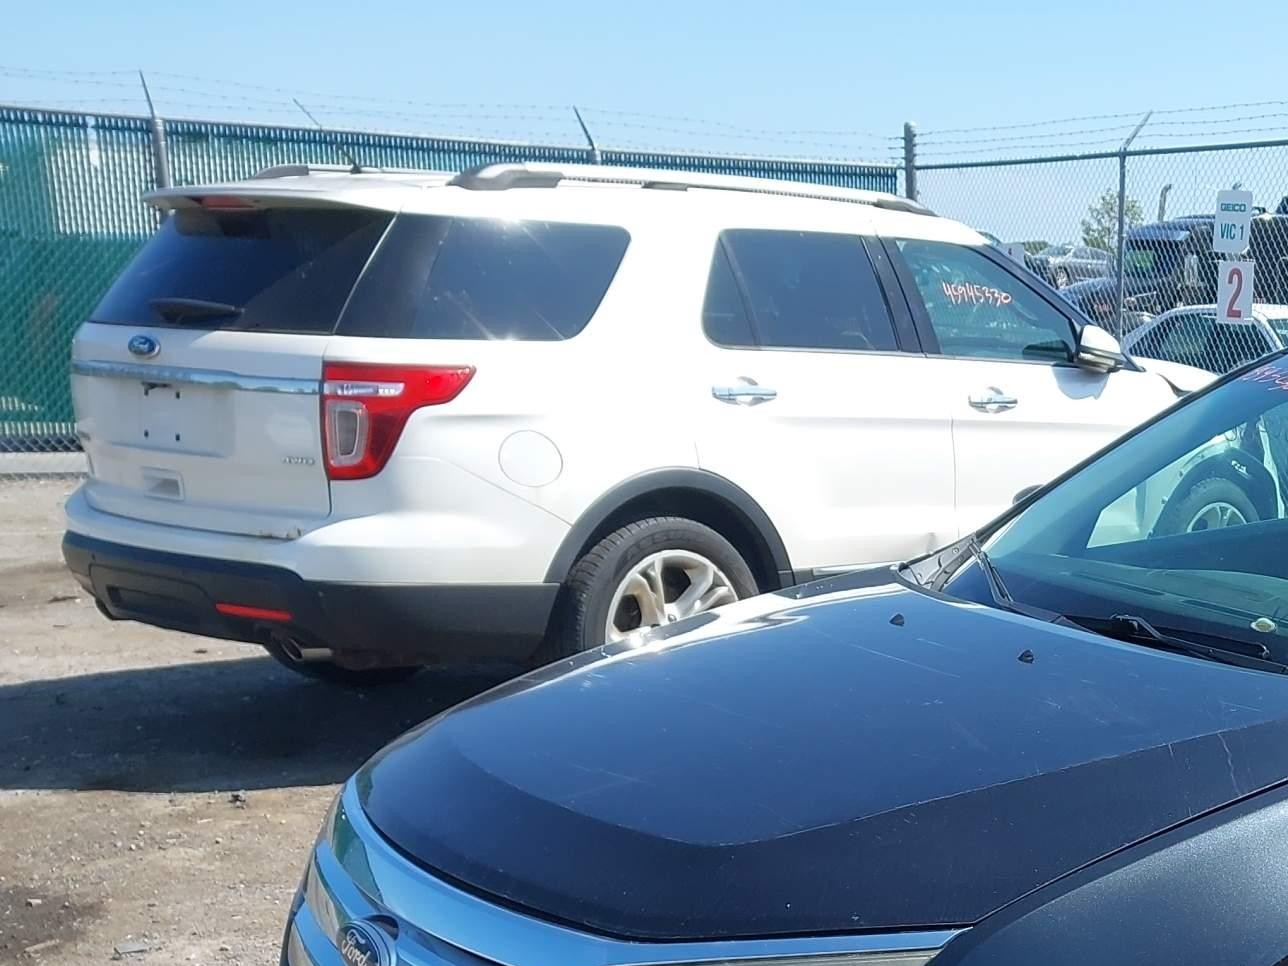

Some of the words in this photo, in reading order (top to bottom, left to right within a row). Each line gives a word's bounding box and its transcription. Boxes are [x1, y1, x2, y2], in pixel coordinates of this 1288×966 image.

[1220, 203, 1246, 212] GEICO
[1220, 223, 1236, 240] VIC
[1239, 224, 1244, 240] 1
[1226, 267, 1243, 318] 2
